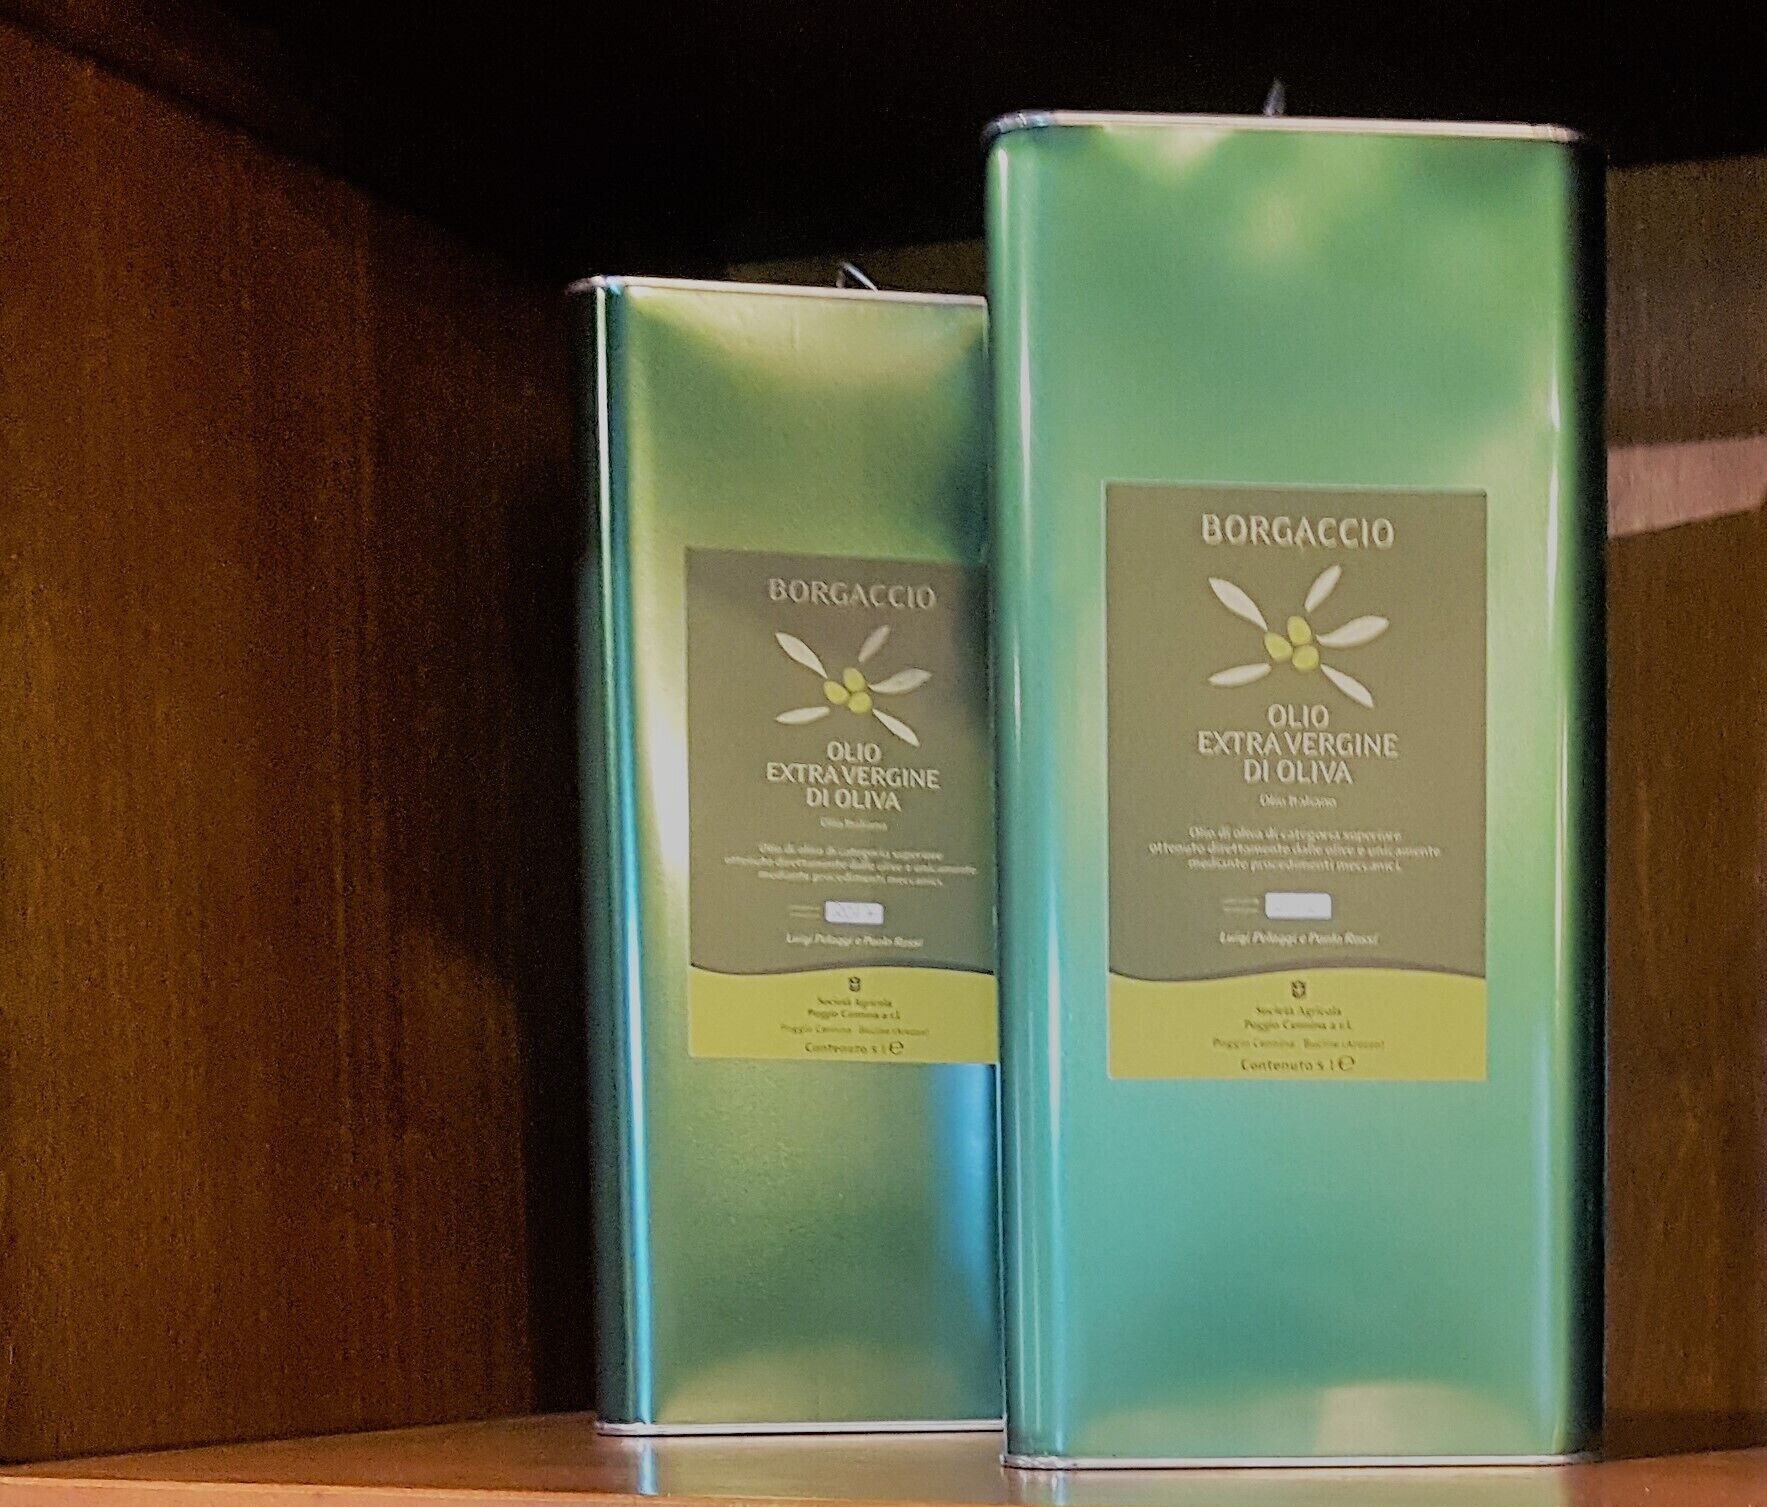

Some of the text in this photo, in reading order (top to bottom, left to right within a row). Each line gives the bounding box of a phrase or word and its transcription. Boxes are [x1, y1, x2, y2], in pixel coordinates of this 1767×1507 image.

[1201, 514, 1395, 550] BORGACCIO
[768, 577, 937, 609] BORGACCIO
[1268, 704, 1329, 729] OLIO
[826, 740, 882, 764] OLIO
[1244, 759, 1353, 785] DI OLIVA
[806, 787, 902, 812] DI OLIVA
[1241, 1058, 1313, 1071] Contenuto
